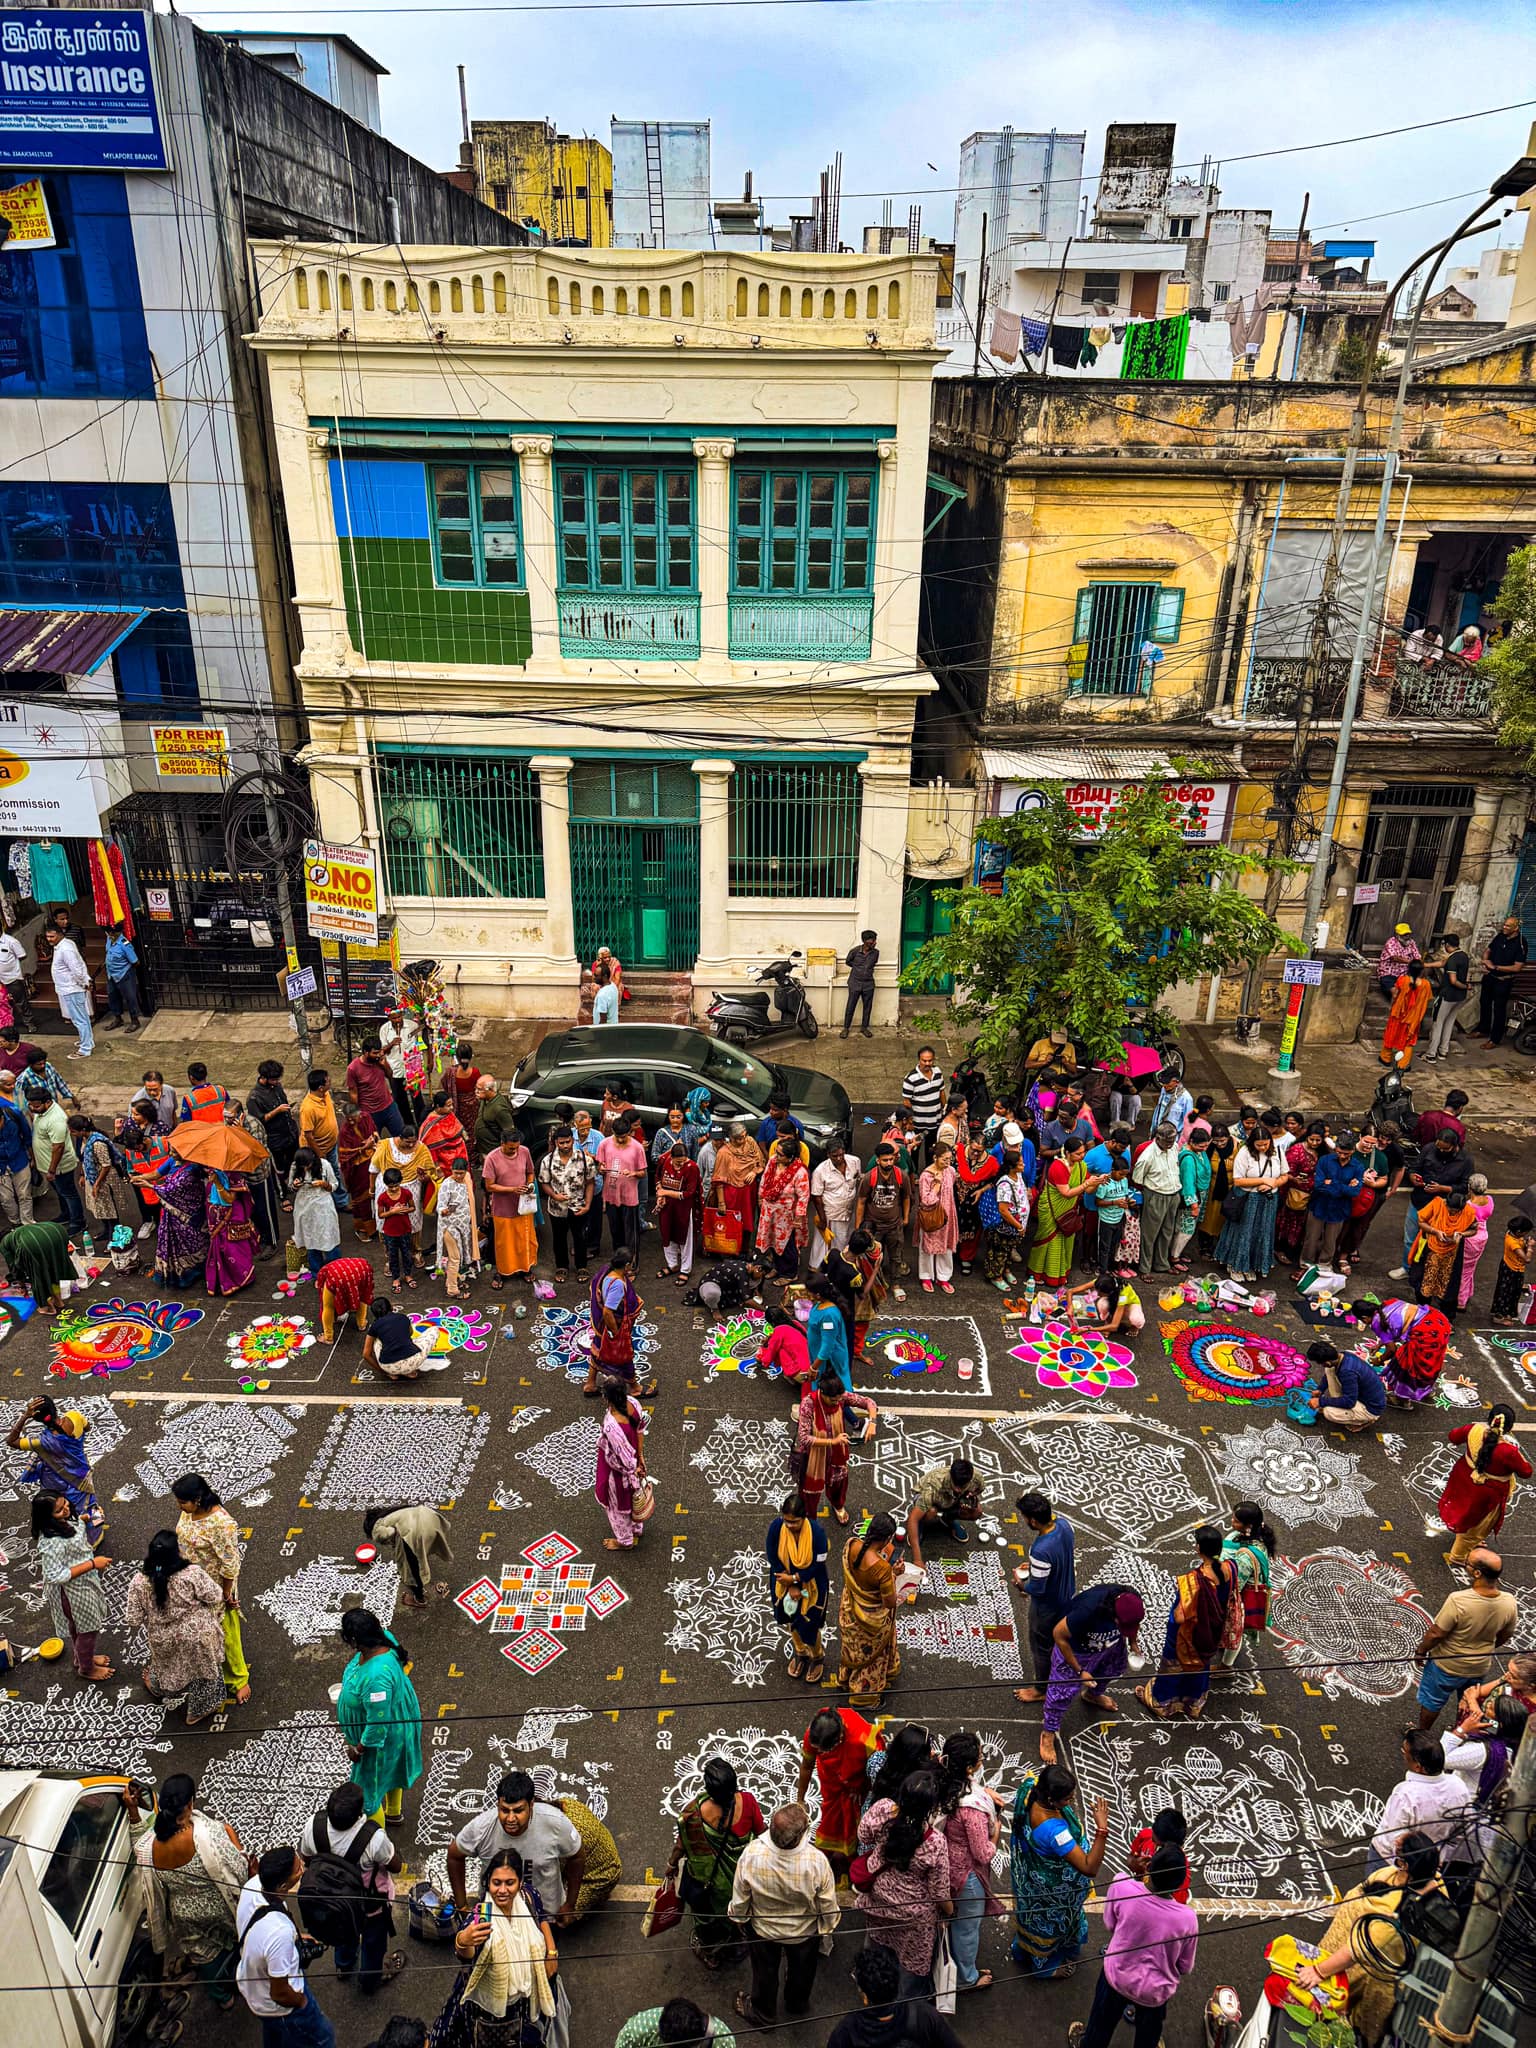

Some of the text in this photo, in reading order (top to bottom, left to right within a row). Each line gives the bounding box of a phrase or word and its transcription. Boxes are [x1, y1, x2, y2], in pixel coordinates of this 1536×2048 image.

[2, 19, 140, 56] இன்சூரன்ஸ்
[1, 60, 146, 94] Insurance
[103, 152, 133, 160] MYLAPORE
[153, 729, 224, 740] FOR RENT
[161, 744, 187, 752] 1250
[322, 852, 366, 865] TRAFFIC POLICE
[344, 850, 369, 859] CHENNAI
[331, 867, 372, 895] NO
[310, 889, 373, 910] PARKING
[1290, 968, 1306, 977] 12
[56, 1308, 75, 1321] R6
[683, 1419, 697, 1432] 31
[280, 1541, 297, 1557] 23
[476, 1544, 492, 1561] 26
[671, 1546, 686, 1563] 30
[432, 1725, 450, 1746] 25
[656, 1730, 673, 1750] 29
[1328, 1743, 1350, 1765] 38
[1296, 1843, 1321, 1891] HAPPY
